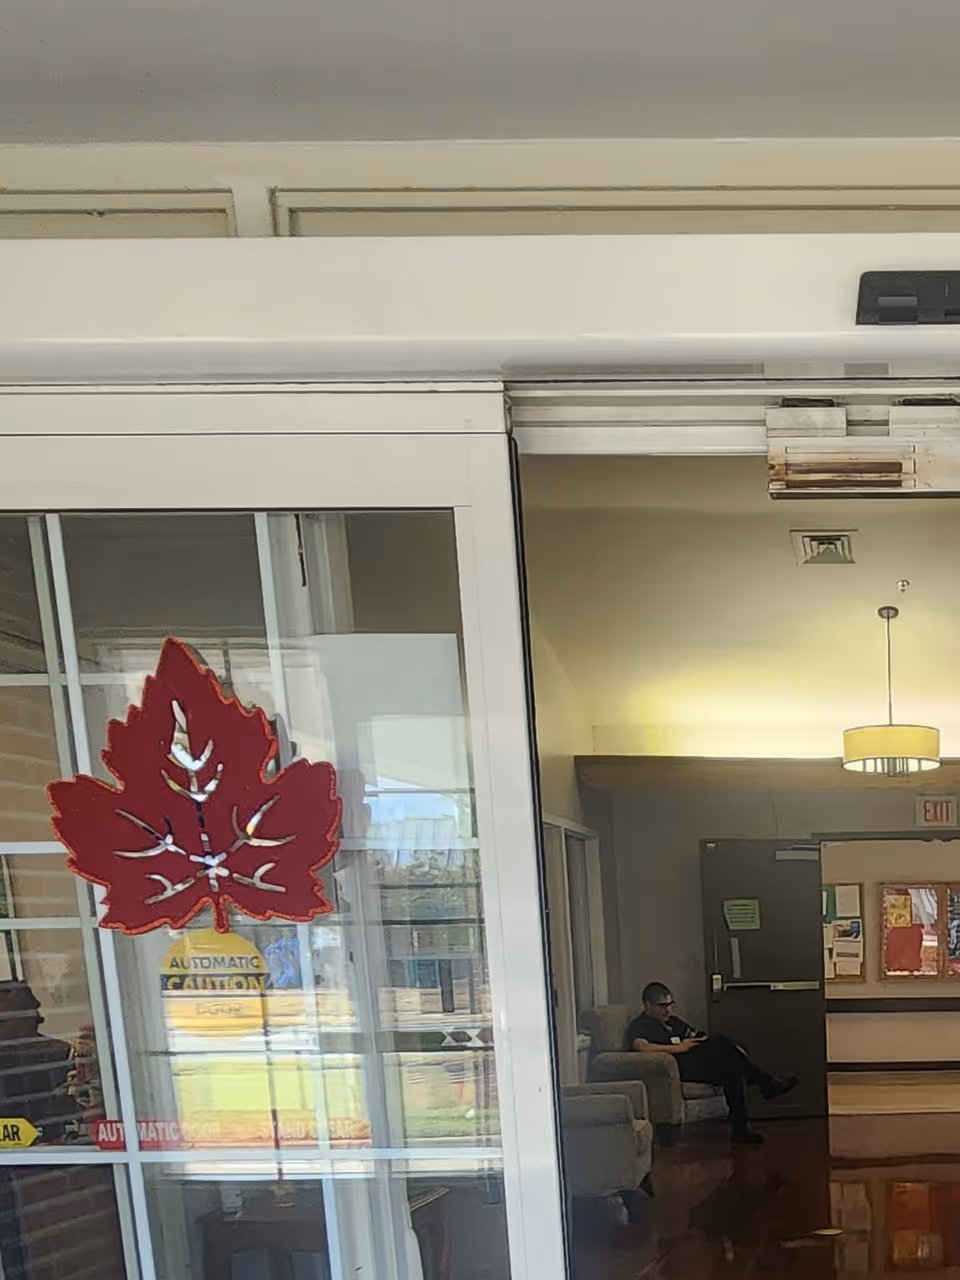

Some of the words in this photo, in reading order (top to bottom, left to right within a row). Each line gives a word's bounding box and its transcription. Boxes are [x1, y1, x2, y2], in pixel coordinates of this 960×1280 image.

[924, 800, 951, 822] EXIT
[169, 956, 260, 970] AUTOMATIC
[98, 1122, 179, 1142] AUTMATIC
